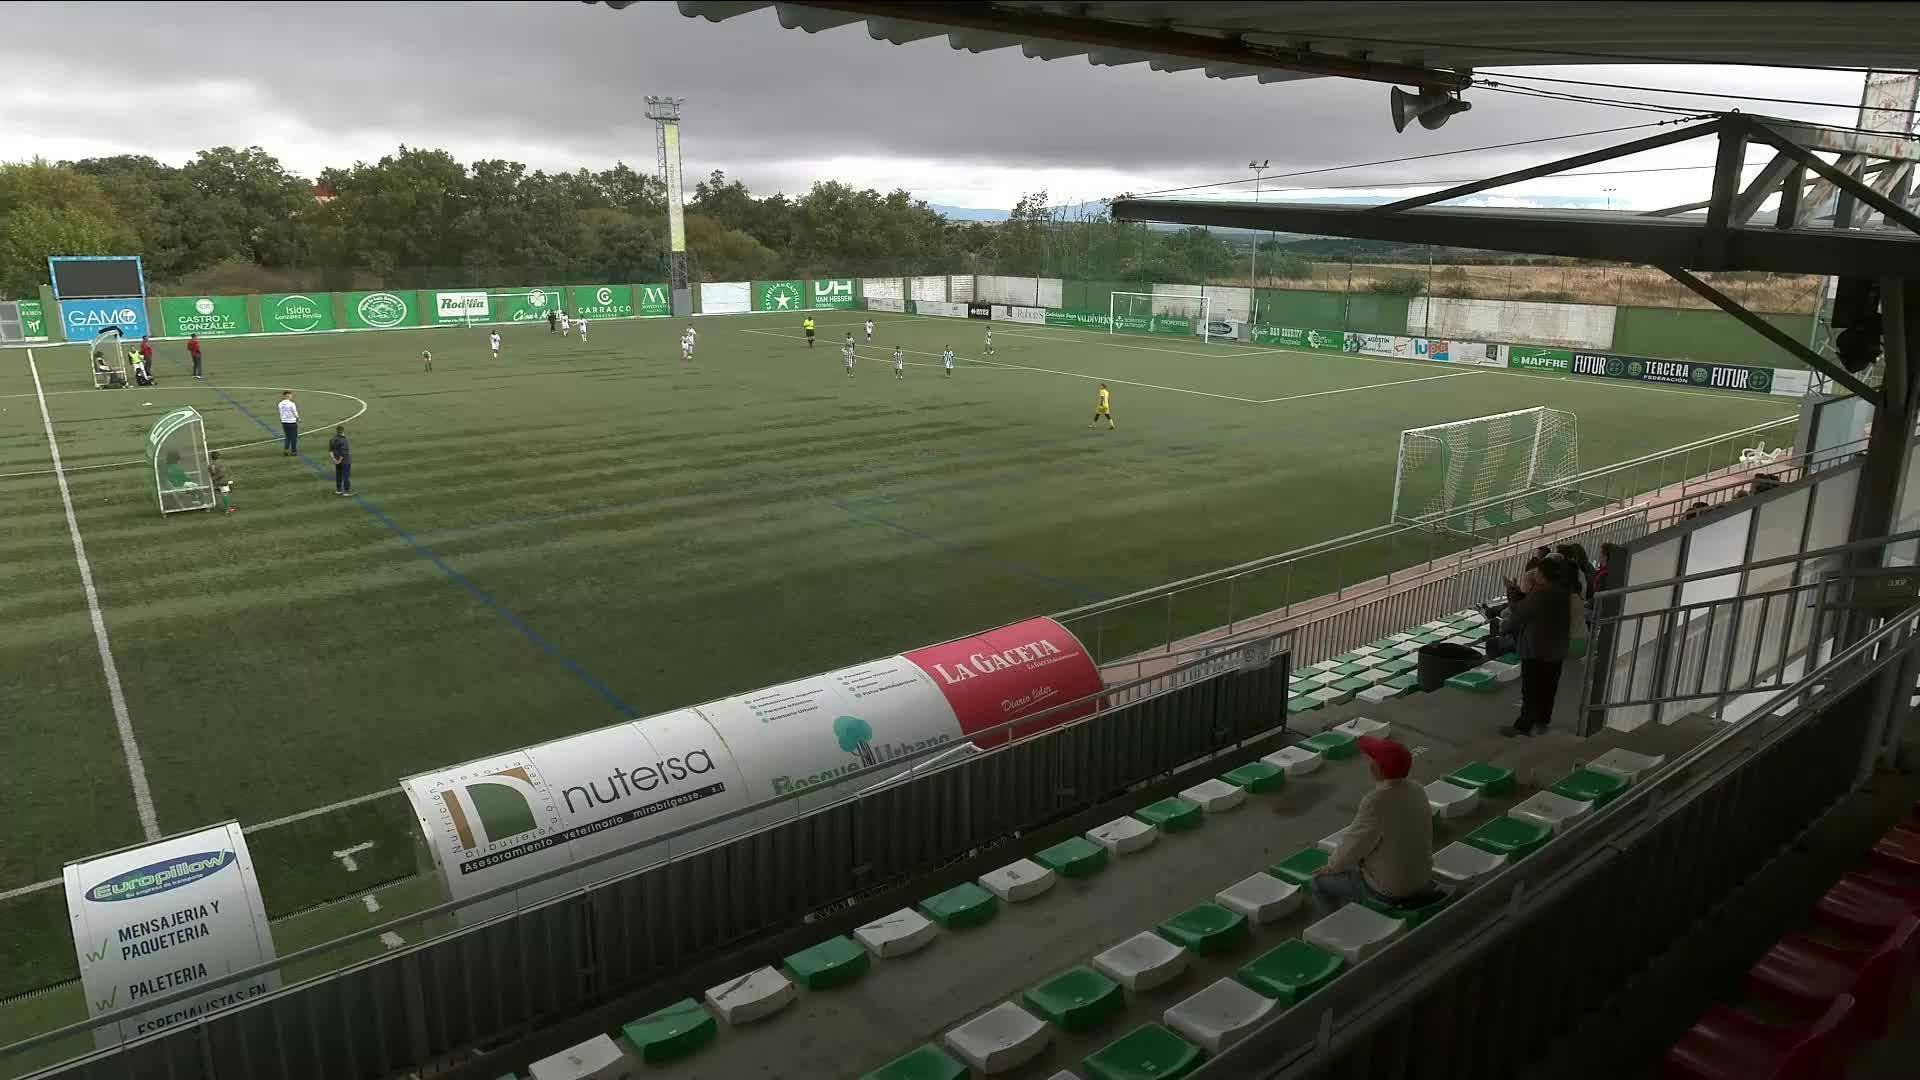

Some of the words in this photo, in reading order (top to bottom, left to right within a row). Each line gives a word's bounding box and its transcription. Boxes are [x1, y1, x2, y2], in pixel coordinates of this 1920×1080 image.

[286, 306, 311, 314] Isidro
[441, 298, 484, 309] Rodilla
[578, 305, 632, 314] CARRASCO
[68, 308, 136, 324] GAMO
[178, 315, 221, 323] CASTRO
[1415, 339, 1448, 359] lupa
[1521, 356, 1568, 369] MAPFRE
[1645, 361, 1689, 377] TERCERA
[1643, 375, 1688, 384] FEDERACIÓN
[932, 663, 978, 685] LA
[970, 639, 1060, 674] GACETA
[561, 748, 716, 814] nutersa
[463, 837, 553, 873] Asesoramiento
[563, 814, 624, 841] veterinario
[94, 848, 225, 900] Europillow
[118, 905, 209, 942] MENSAJERIA
[210, 900, 220, 913] Y
[121, 922, 210, 961] PAQUETERIA
[129, 962, 208, 1000] PALETERIA
